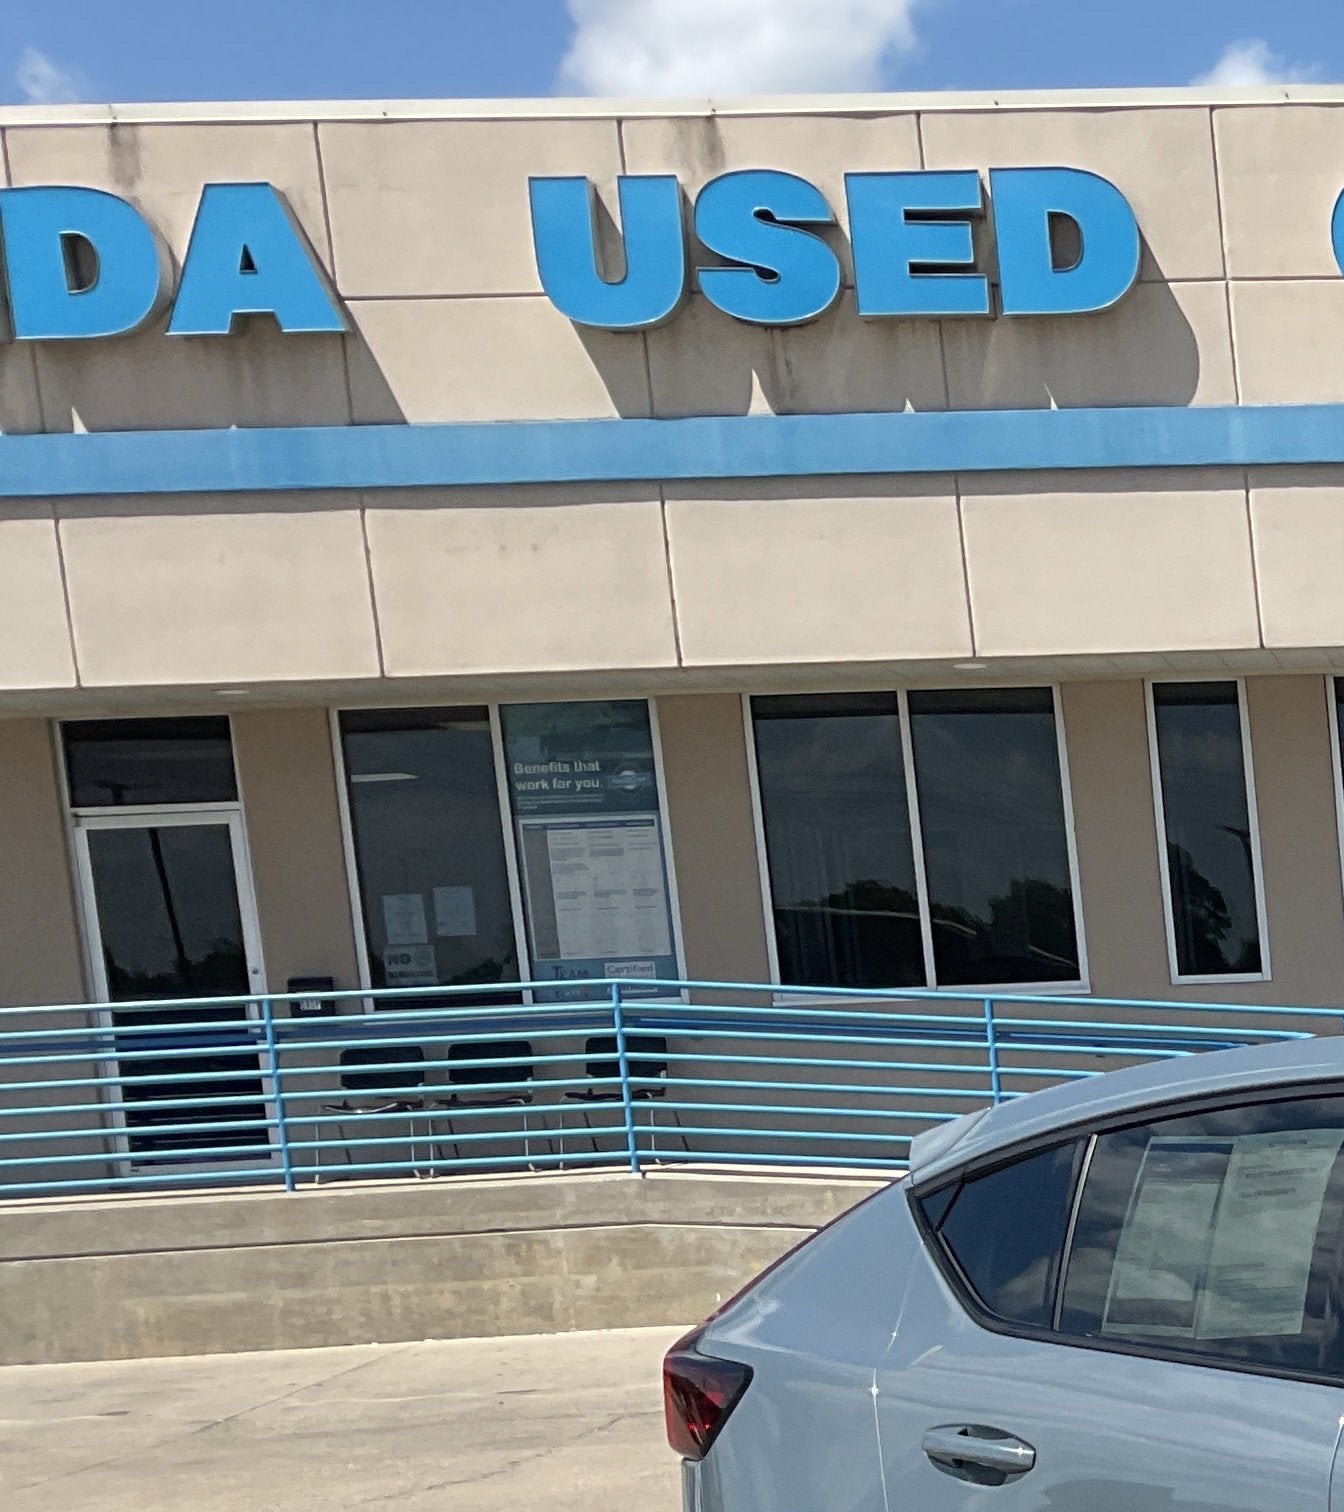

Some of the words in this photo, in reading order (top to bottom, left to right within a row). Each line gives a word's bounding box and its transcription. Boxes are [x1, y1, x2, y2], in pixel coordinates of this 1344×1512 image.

[0, 181, 352, 341] DA
[527, 167, 1142, 329] USED
[513, 760, 571, 775] Benefits
[573, 759, 602, 772] that
[515, 779, 550, 791] work
[552, 777, 572, 789] for
[606, 964, 654, 975] Certified
